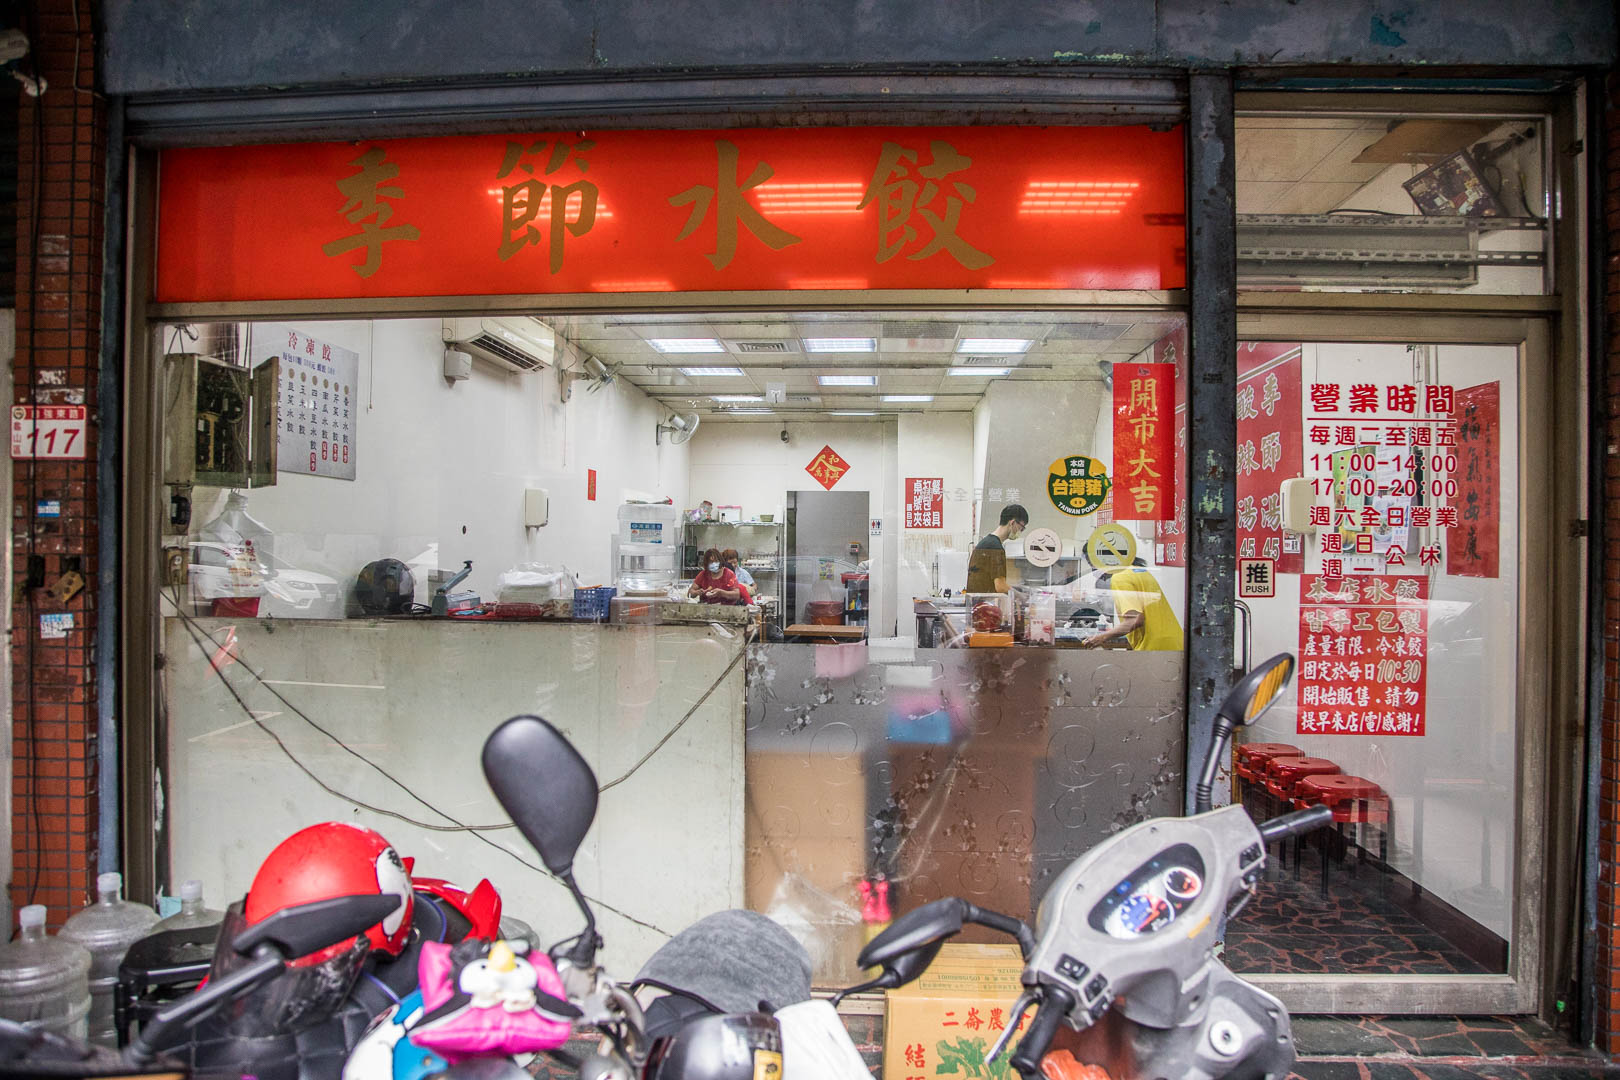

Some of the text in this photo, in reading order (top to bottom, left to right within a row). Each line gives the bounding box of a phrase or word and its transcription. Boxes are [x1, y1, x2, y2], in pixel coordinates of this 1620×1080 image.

[321, 139, 996, 278] 季節水餃
[1311, 383, 1454, 414] 營業時間
[27, 428, 80, 454] 117
[1129, 378, 1161, 514] 開市大吉
[1309, 425, 1456, 446] 每週二至週五
[1236, 385, 1260, 532] 酸辣湯
[1261, 373, 1282, 531] 季節湯
[1310, 453, 1456, 472] 11:00-14:00
[1070, 468, 1085, 476] 使用
[1052, 478, 1102, 496] 台灣豬
[1310, 478, 1456, 497] 17:00-20:00
[1058, 501, 1099, 514] TAIWAN PORK
[1309, 506, 1457, 527] 週六全日營業
[1240, 538, 1256, 558] 45
[1262, 537, 1280, 561] 45
[1321, 533, 1373, 554] 週日
[1386, 544, 1440, 566] 公休
[1246, 563, 1269, 583] 推
[1322, 559, 1375, 579] 週一
[1305, 577, 1421, 605] 本店水餃
[1304, 609, 1424, 634] 皆手工包製
[1303, 659, 1421, 684] 固定於每日10:30
[905, 1043, 926, 1080] 結
